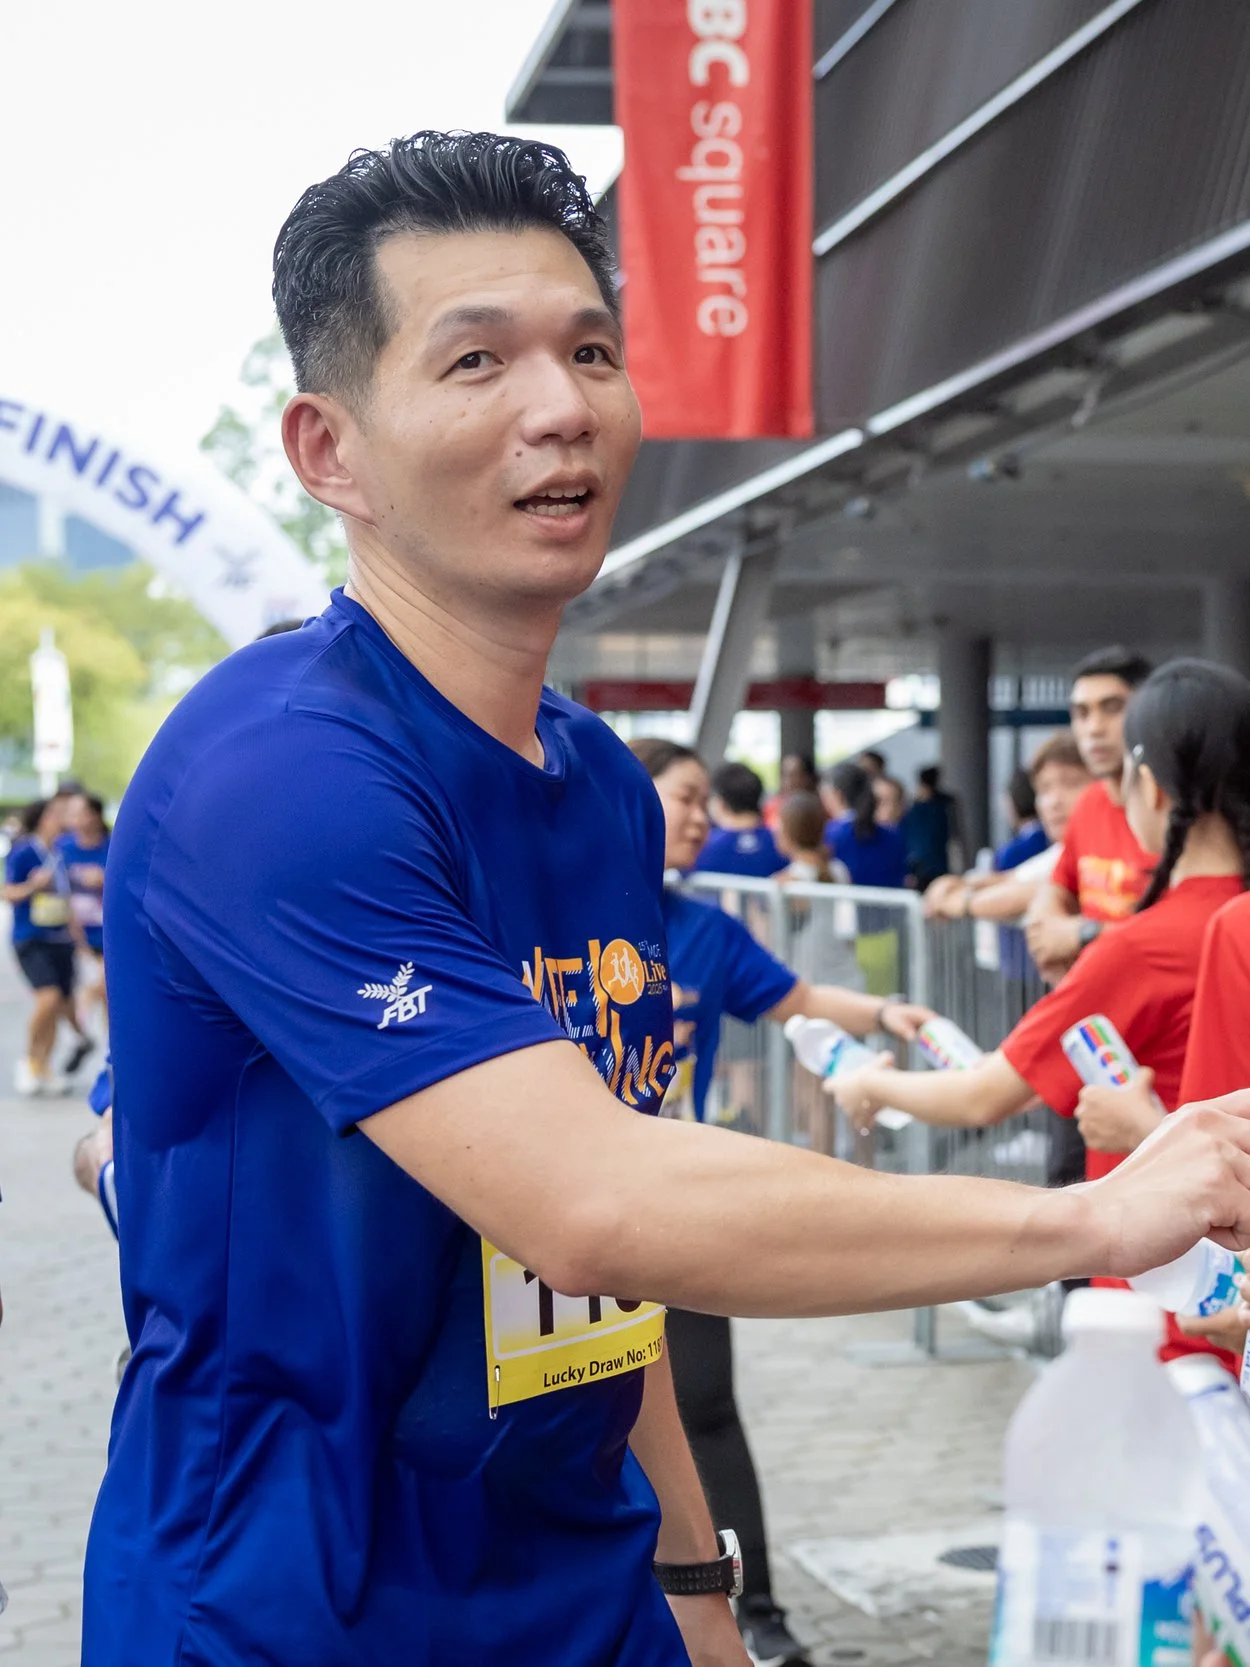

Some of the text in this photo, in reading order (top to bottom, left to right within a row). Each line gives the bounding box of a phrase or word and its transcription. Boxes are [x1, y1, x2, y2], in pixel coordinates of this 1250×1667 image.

[675, 101, 749, 337] square
[377, 985, 433, 1030] FBT
[543, 1365, 585, 1388] Lucky
[589, 1356, 624, 1377] Draw
[626, 1348, 647, 1366] No:
